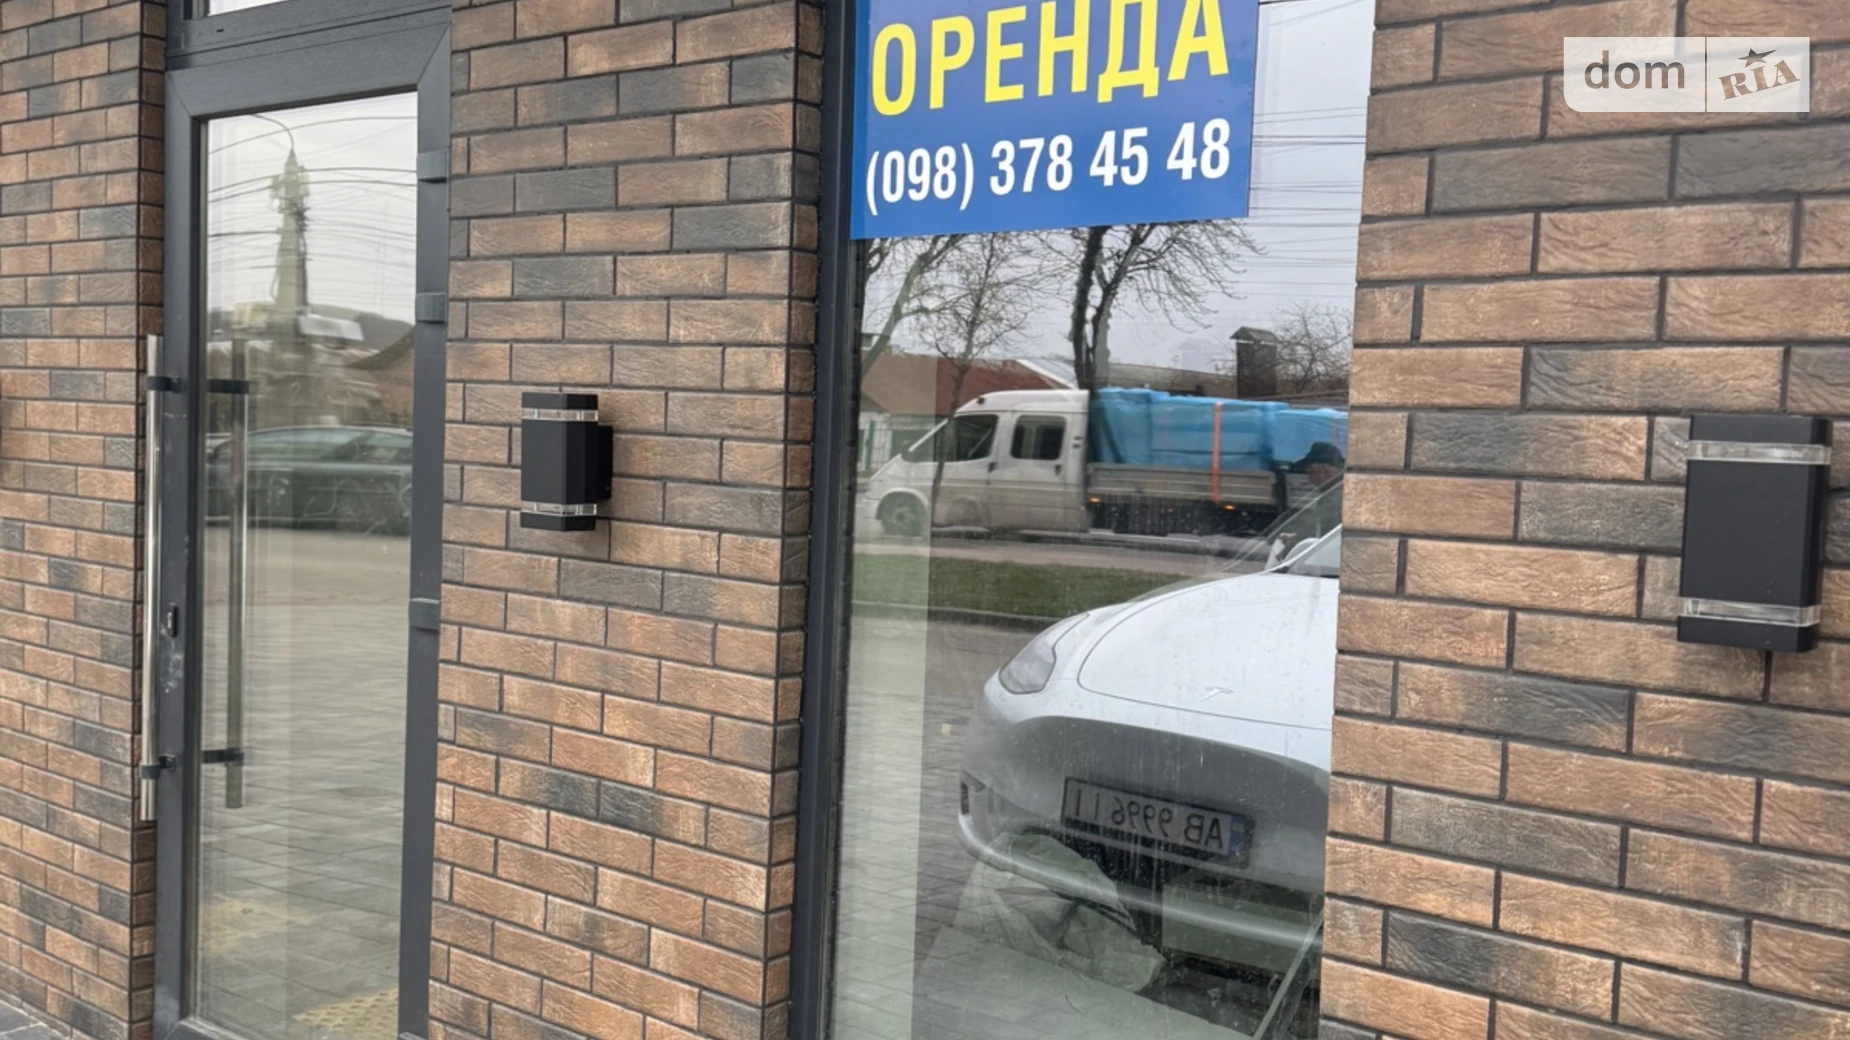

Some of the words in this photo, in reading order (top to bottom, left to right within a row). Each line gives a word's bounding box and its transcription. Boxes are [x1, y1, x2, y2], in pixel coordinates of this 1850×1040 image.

[872, 0, 1229, 116] ОРЕНДА
[866, 142, 974, 215] (098)
[990, 134, 1073, 195] 378
[1090, 127, 1149, 186] 45
[1167, 118, 1230, 180] 48
